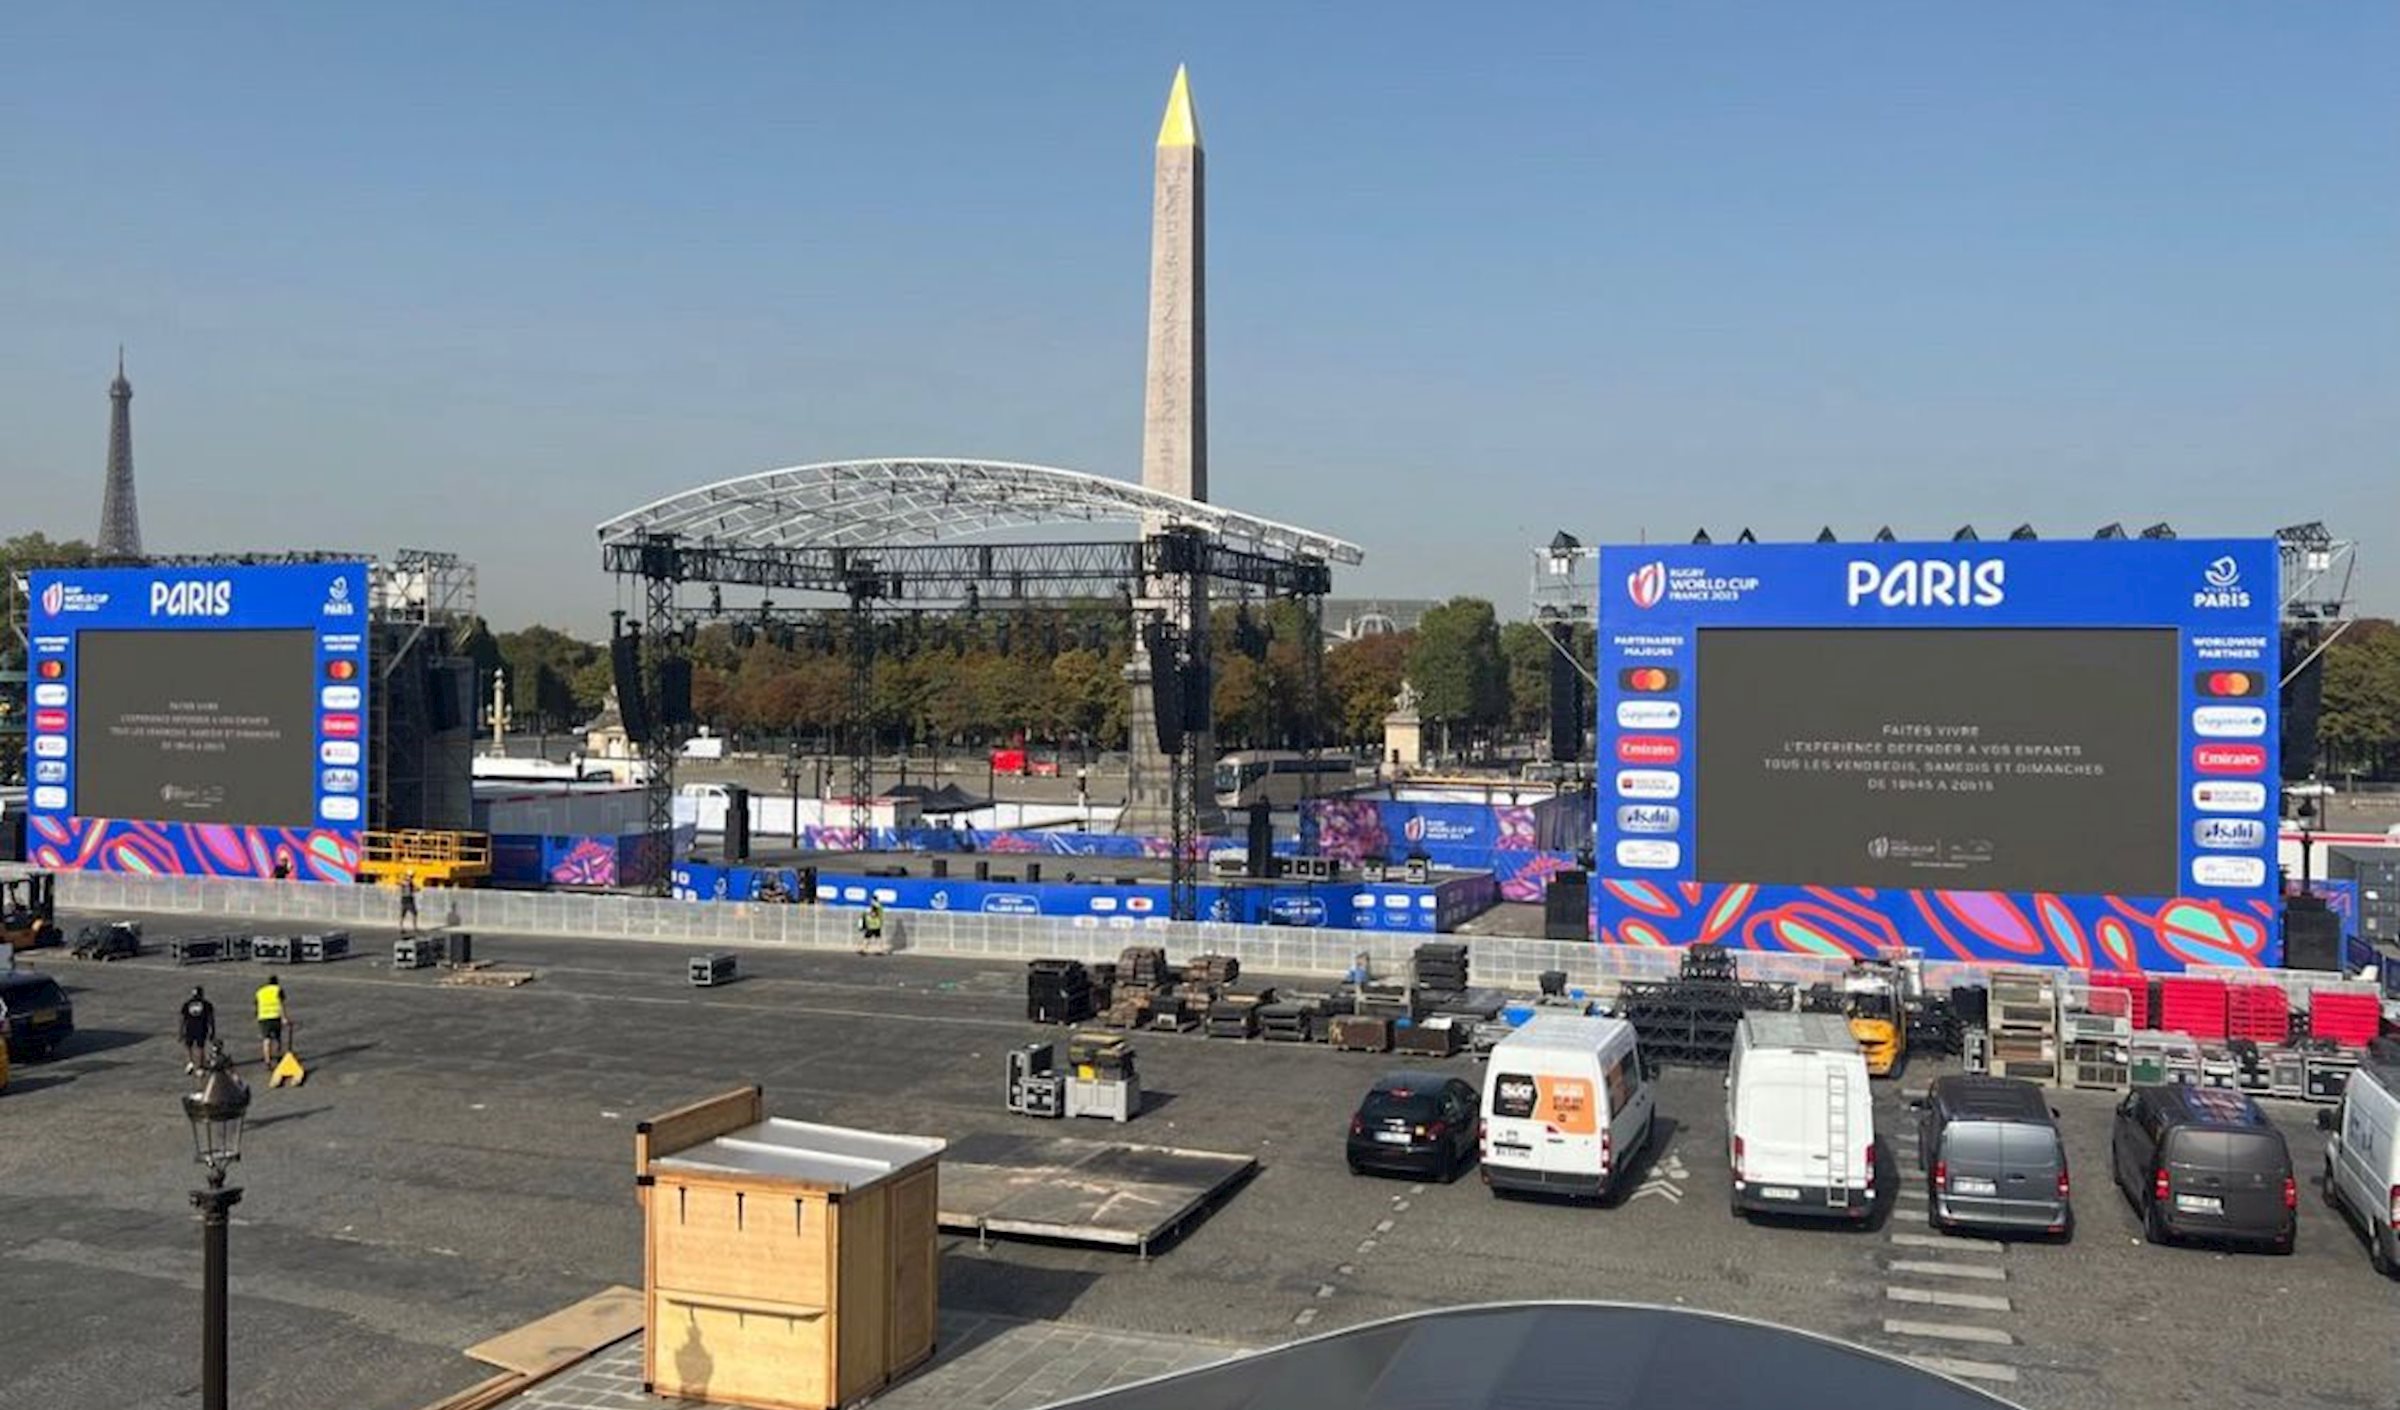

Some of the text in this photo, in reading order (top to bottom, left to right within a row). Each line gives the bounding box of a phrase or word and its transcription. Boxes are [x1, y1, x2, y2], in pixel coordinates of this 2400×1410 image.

[1669, 577, 1759, 591] WORLD CUP
[1848, 559, 2005, 607] PARIS
[150, 580, 232, 616] PARIS
[2193, 592, 2251, 607] PARIS
[2192, 637, 2267, 648] WORLDWIDE
[2198, 649, 2260, 659] PARTNERS
[1882, 724, 1979, 737] FAITES VIVRE
[1887, 743, 1963, 754] DEFENDER
[1981, 744, 2011, 756] VOS
[2014, 745, 2082, 756] ENFANTS
[2198, 751, 2261, 766] Emirates
[1764, 758, 1800, 769] TOUS
[1803, 759, 1831, 770] LES
[1923, 761, 1990, 773] SAMEDIS
[1993, 762, 2012, 774] ET
[2015, 763, 2104, 775] DIMANCHES
[1868, 778, 1886, 790] DE
[1627, 808, 1670, 824] Asahi
[2204, 821, 2254, 838] Asahi
